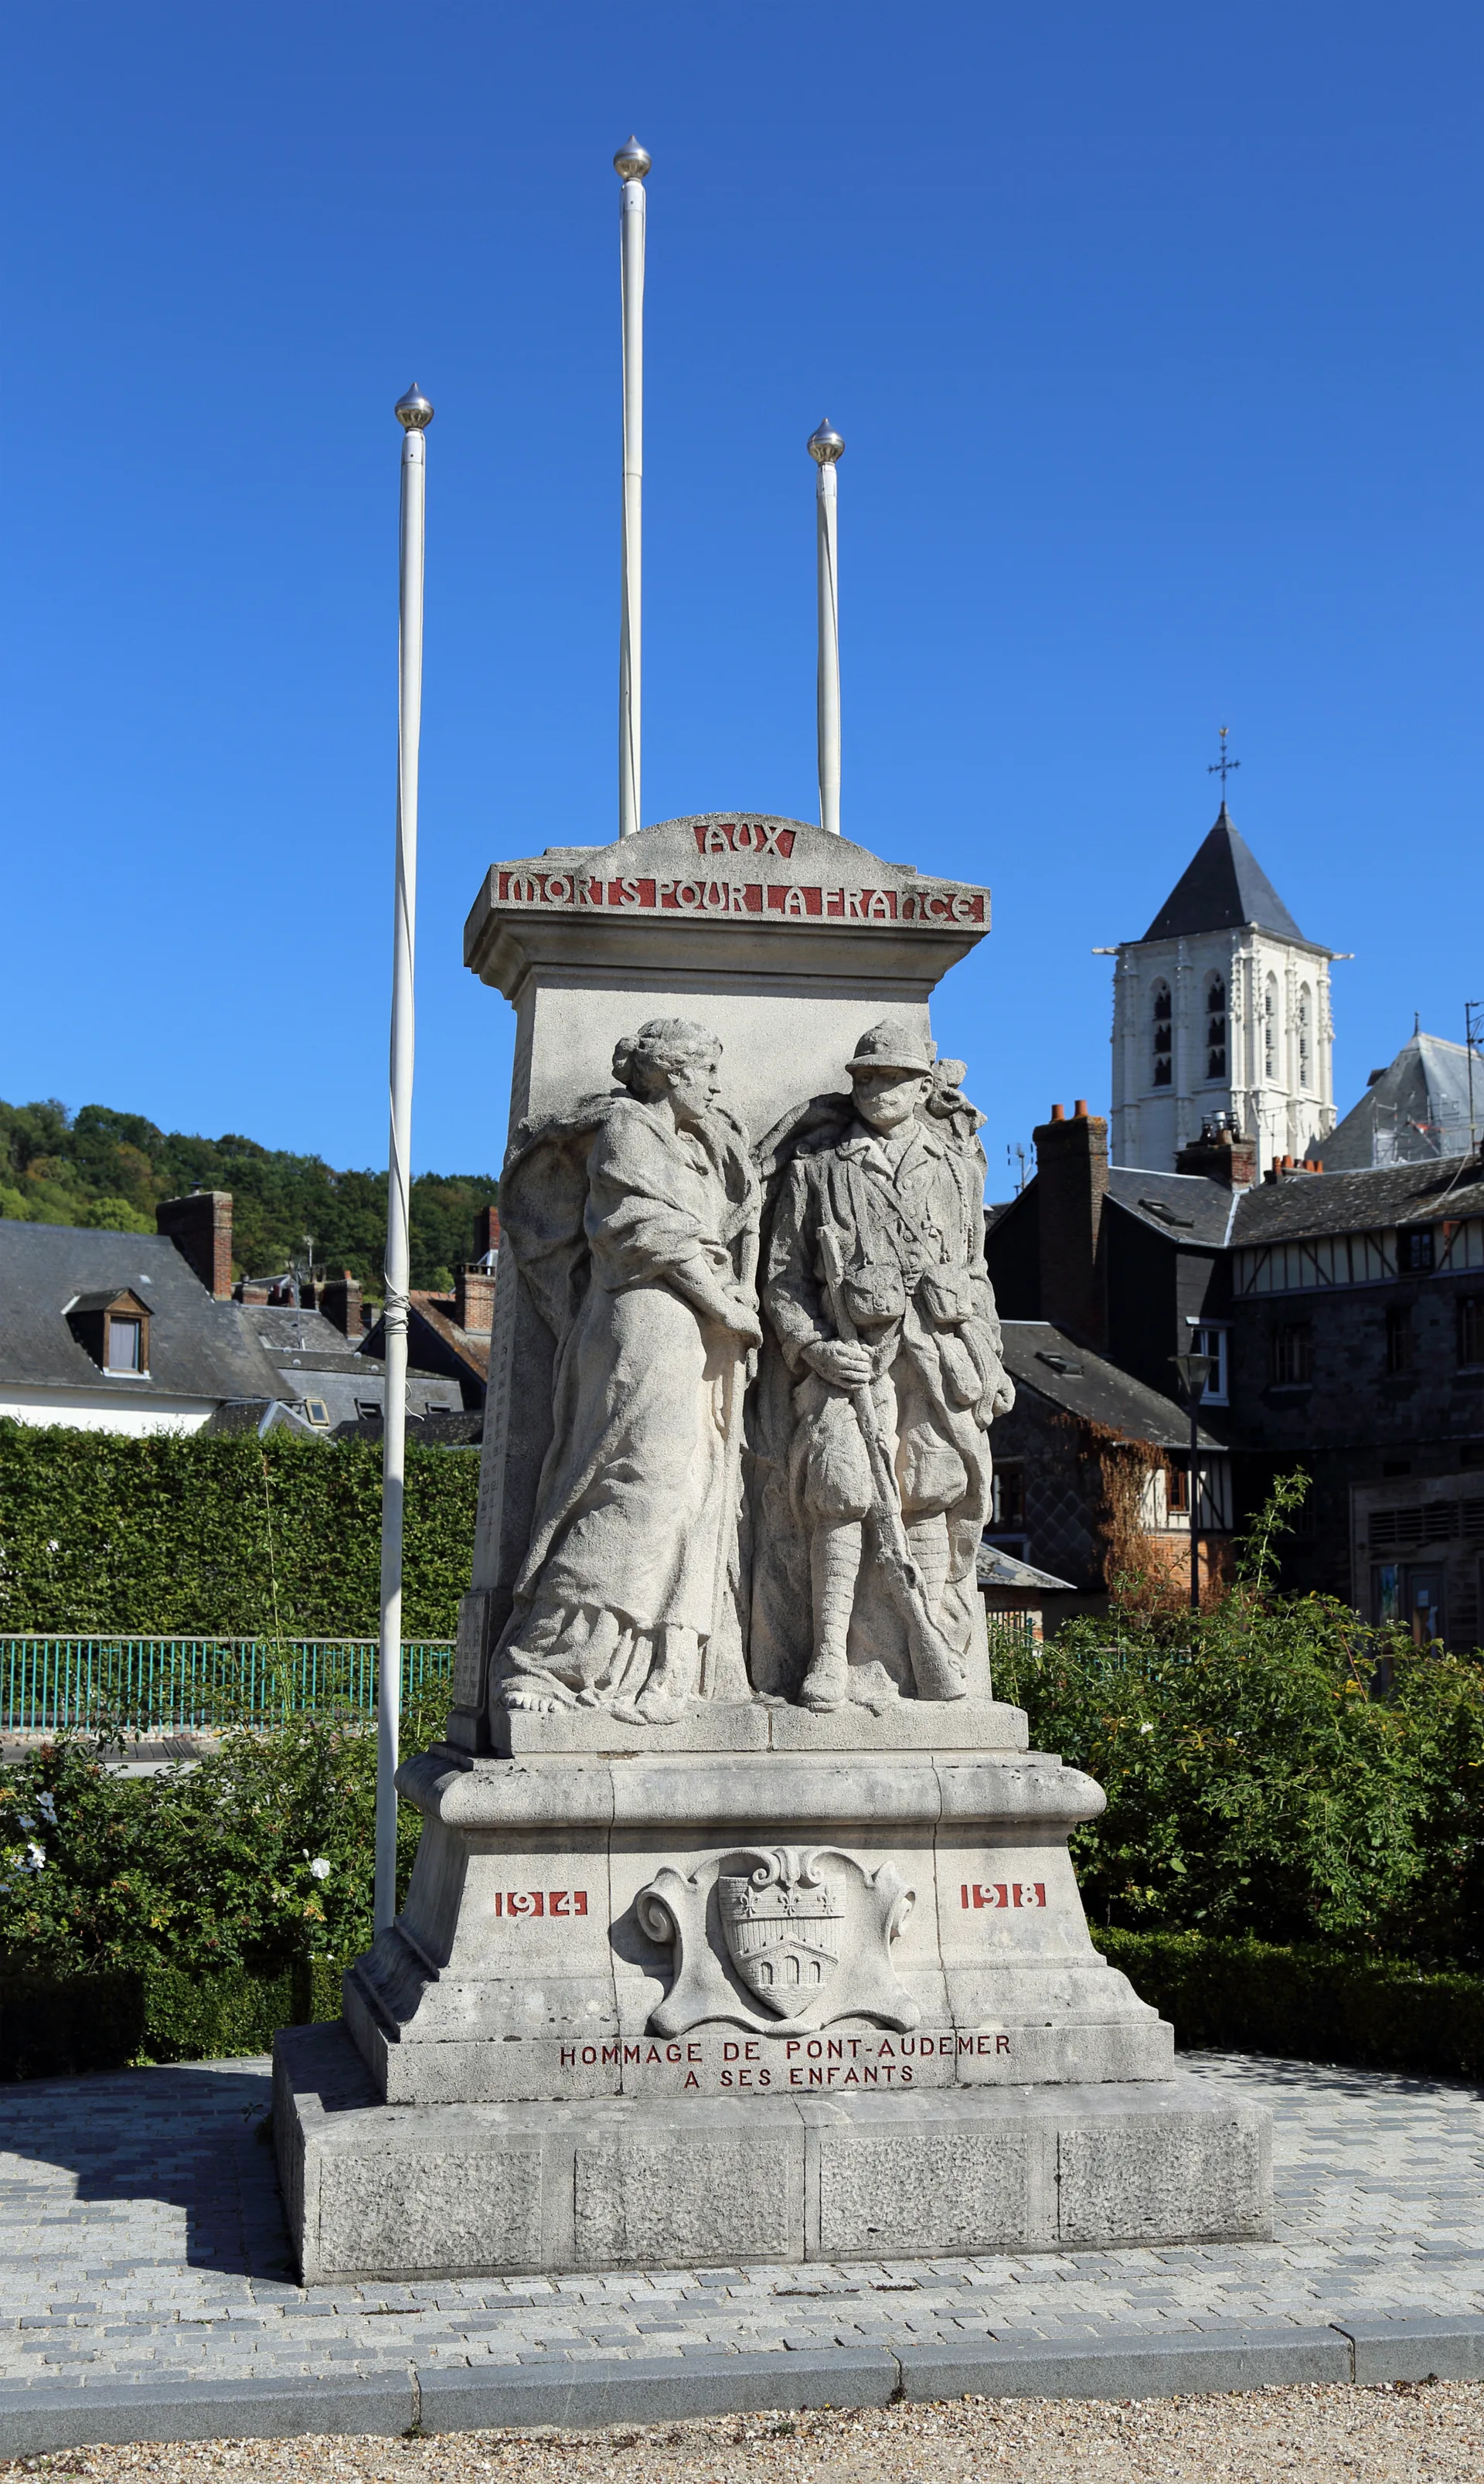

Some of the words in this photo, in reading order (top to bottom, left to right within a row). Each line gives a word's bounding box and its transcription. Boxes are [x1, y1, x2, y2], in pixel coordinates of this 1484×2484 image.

[703, 822, 784, 857] AUX
[507, 873, 641, 907] MORTS
[655, 880, 747, 912] POUR
[762, 885, 807, 916] LA
[821, 887, 975, 923] FRANCE
[500, 1891, 582, 1917] 1914
[966, 1883, 1040, 1908] 1918
[560, 2043, 703, 2066] HOMMAGE
[723, 2041, 761, 2062] DE
[786, 2035, 1011, 2060] PONT-AUDEMER
[683, 2071, 700, 2088] A
[720, 2069, 771, 2088] SES
[789, 2065, 914, 2085] ENFANTS
